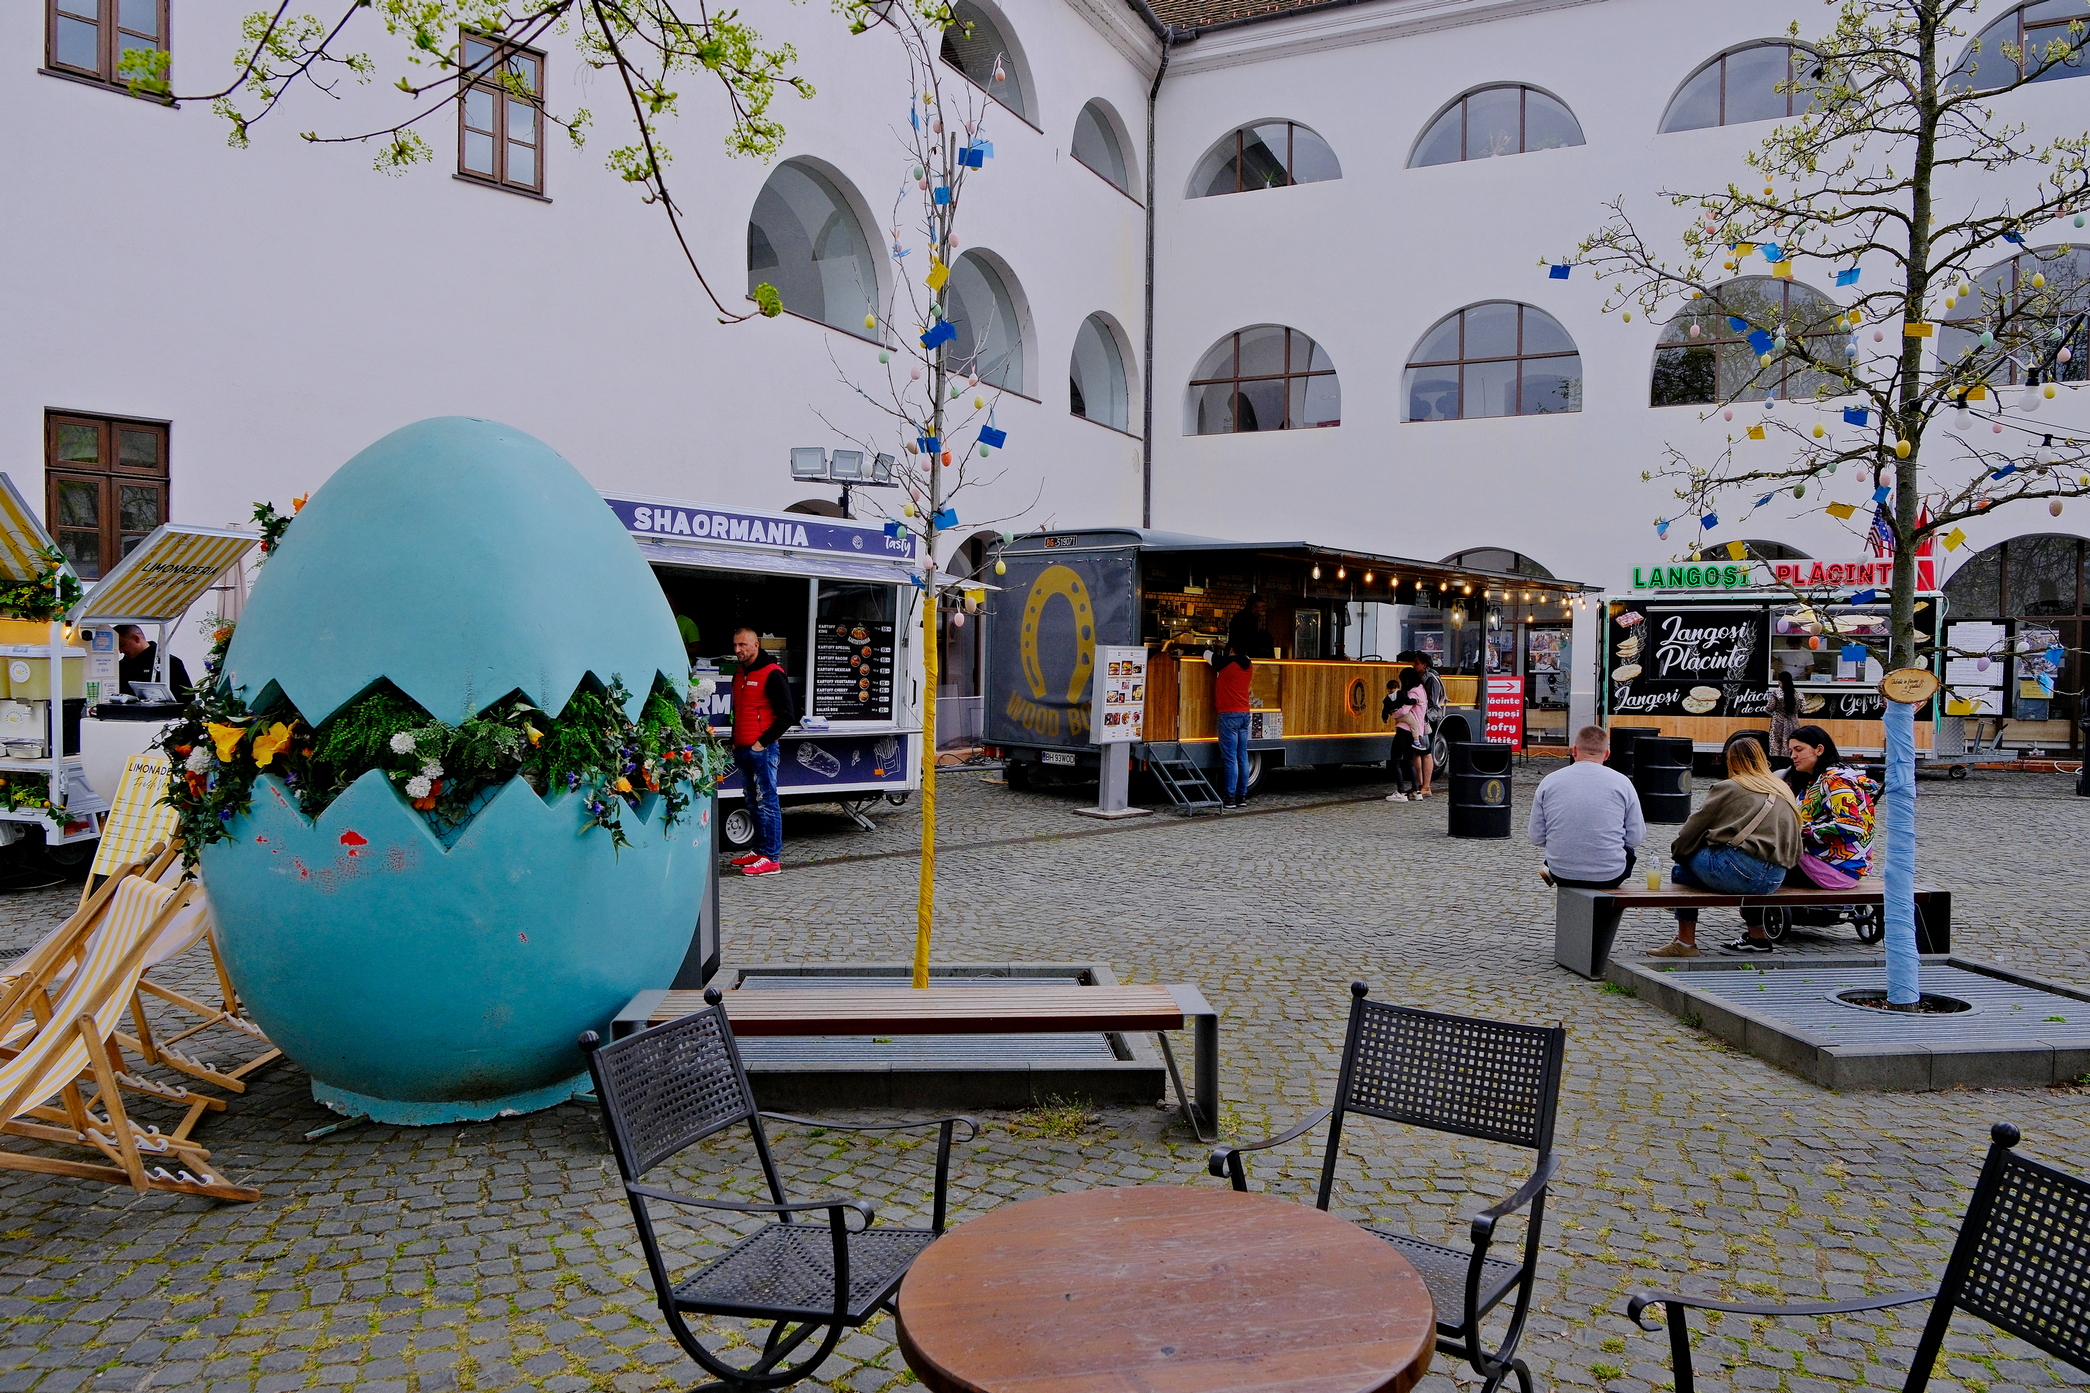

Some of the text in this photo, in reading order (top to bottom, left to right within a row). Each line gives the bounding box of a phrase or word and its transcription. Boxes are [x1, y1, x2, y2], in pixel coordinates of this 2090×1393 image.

[633, 506, 809, 547] SHAORMANIA
[884, 534, 911, 558] Tasty
[141, 562, 220, 576] LIMONADERIA
[1633, 564, 1751, 589] LANGOȘI
[1775, 561, 1894, 586] PLĂCINT
[1659, 615, 1748, 649] Langoși
[1656, 643, 1749, 676] Plăcinte
[1487, 697, 1520, 705] lăcinte
[1613, 685, 1681, 712] Langoși
[1733, 688, 1883, 716] plăci Gofry
[1741, 703, 1767, 714] de ca
[1006, 690, 1060, 737] WOOD
[1067, 700, 1092, 736] BO
[1487, 709, 1520, 719] angoși
[1487, 736, 1519, 745] lătite
[128, 762, 172, 776] LIMONADE
